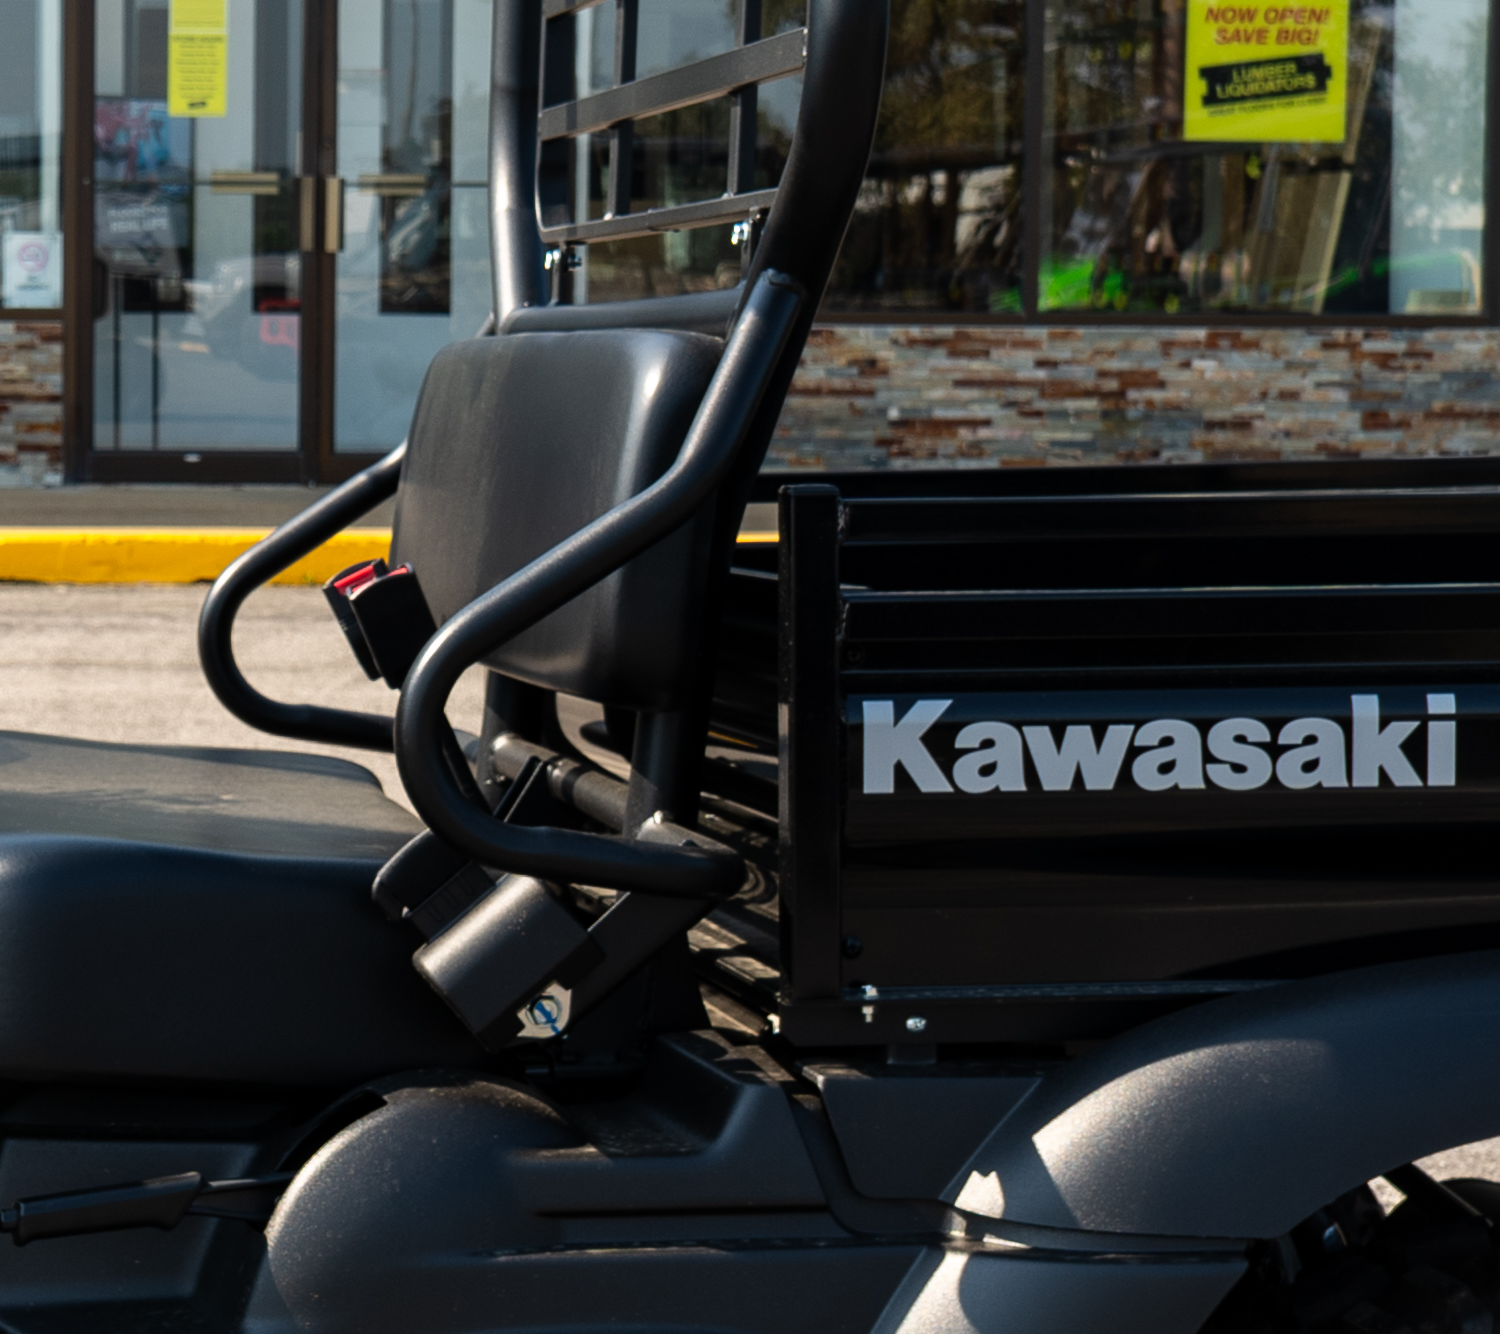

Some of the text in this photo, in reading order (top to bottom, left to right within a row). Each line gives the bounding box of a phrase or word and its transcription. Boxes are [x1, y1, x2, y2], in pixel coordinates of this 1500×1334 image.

[1203, 6, 1331, 26] NOW OPEN!
[1214, 27, 1321, 46] SAVE BIG!
[862, 693, 1457, 795] Kawasaki
